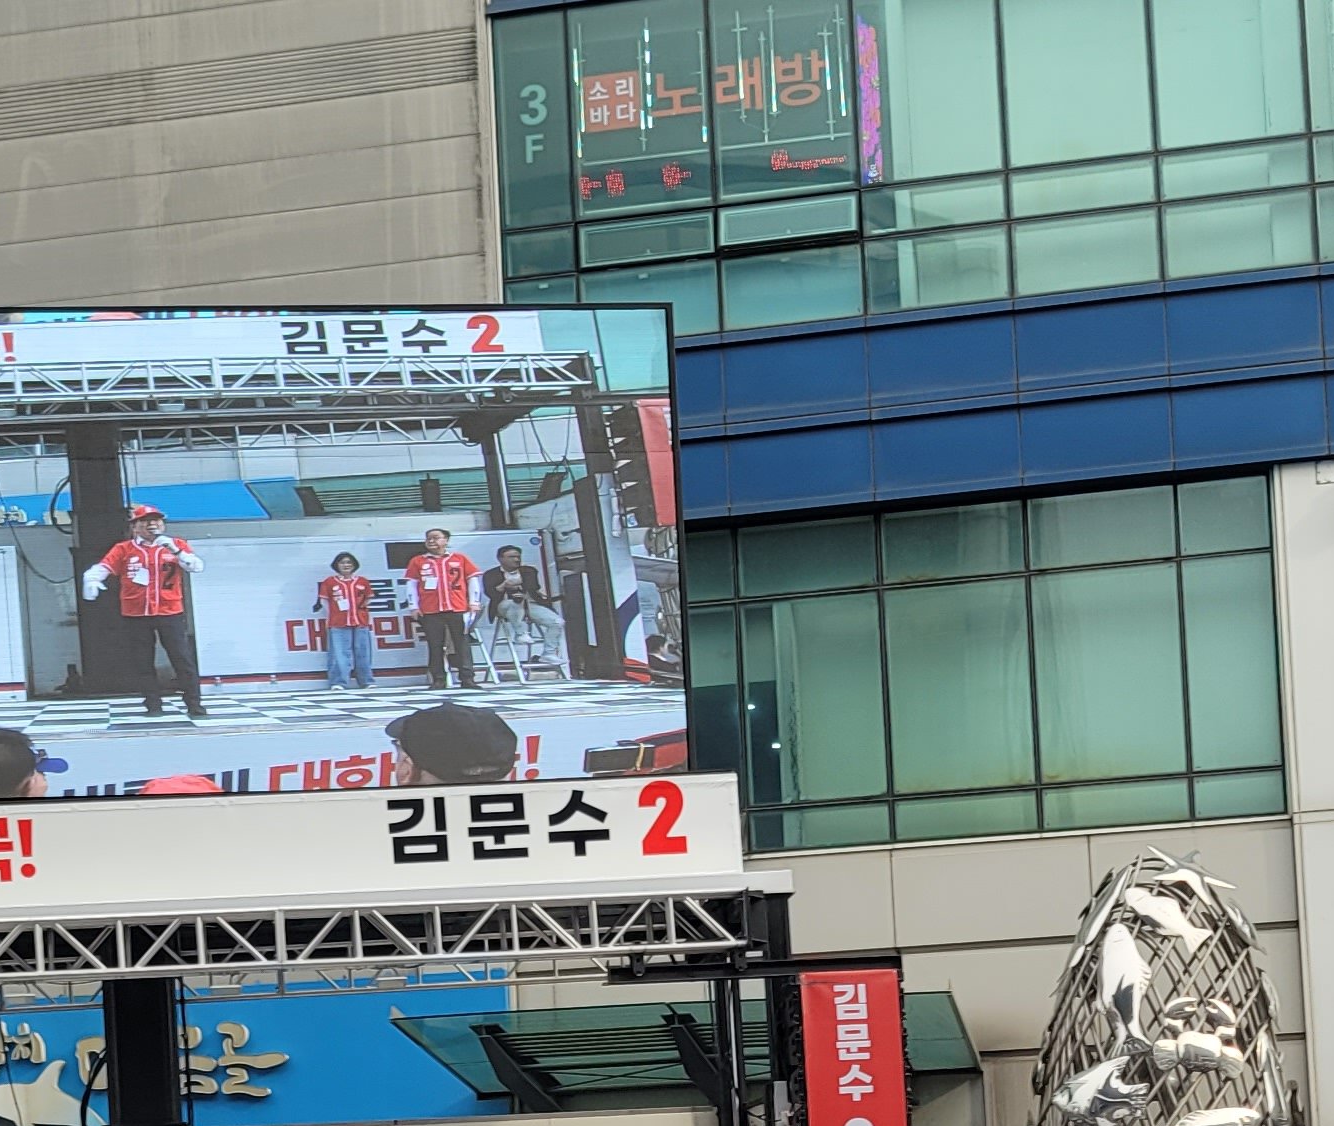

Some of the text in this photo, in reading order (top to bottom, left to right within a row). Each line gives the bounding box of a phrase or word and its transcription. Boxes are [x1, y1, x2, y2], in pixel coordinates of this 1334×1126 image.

[587, 79, 635, 102] 소리
[651, 48, 829, 119] 노래방
[519, 83, 548, 127] 3
[588, 101, 637, 127] 바다
[524, 133, 545, 164] F
[281, 314, 505, 355] 김문수 2
[387, 779, 688, 865] 김문수 2
[832, 983, 875, 1102] 김문수
